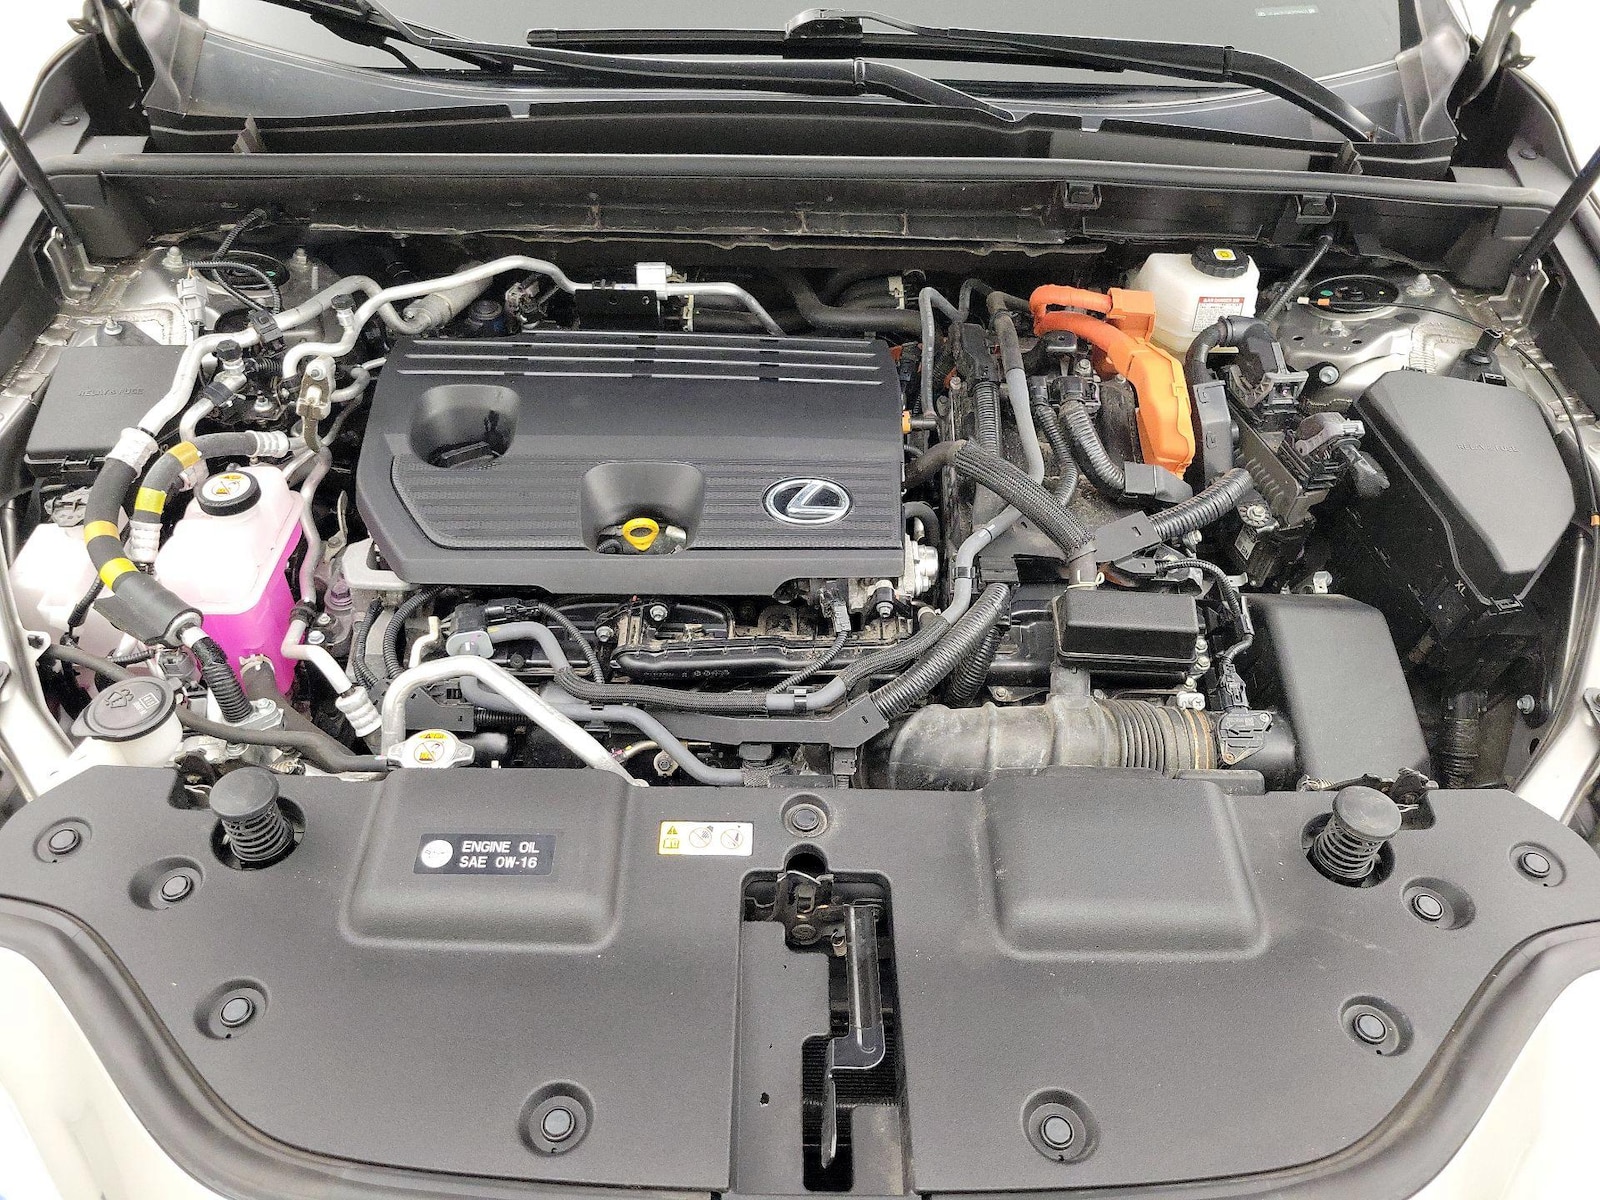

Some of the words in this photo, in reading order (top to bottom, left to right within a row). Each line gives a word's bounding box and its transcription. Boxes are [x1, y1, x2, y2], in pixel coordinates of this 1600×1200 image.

[461, 840, 512, 853] ENGINE
[518, 840, 540, 854] OIL
[459, 855, 488, 868] SAE
